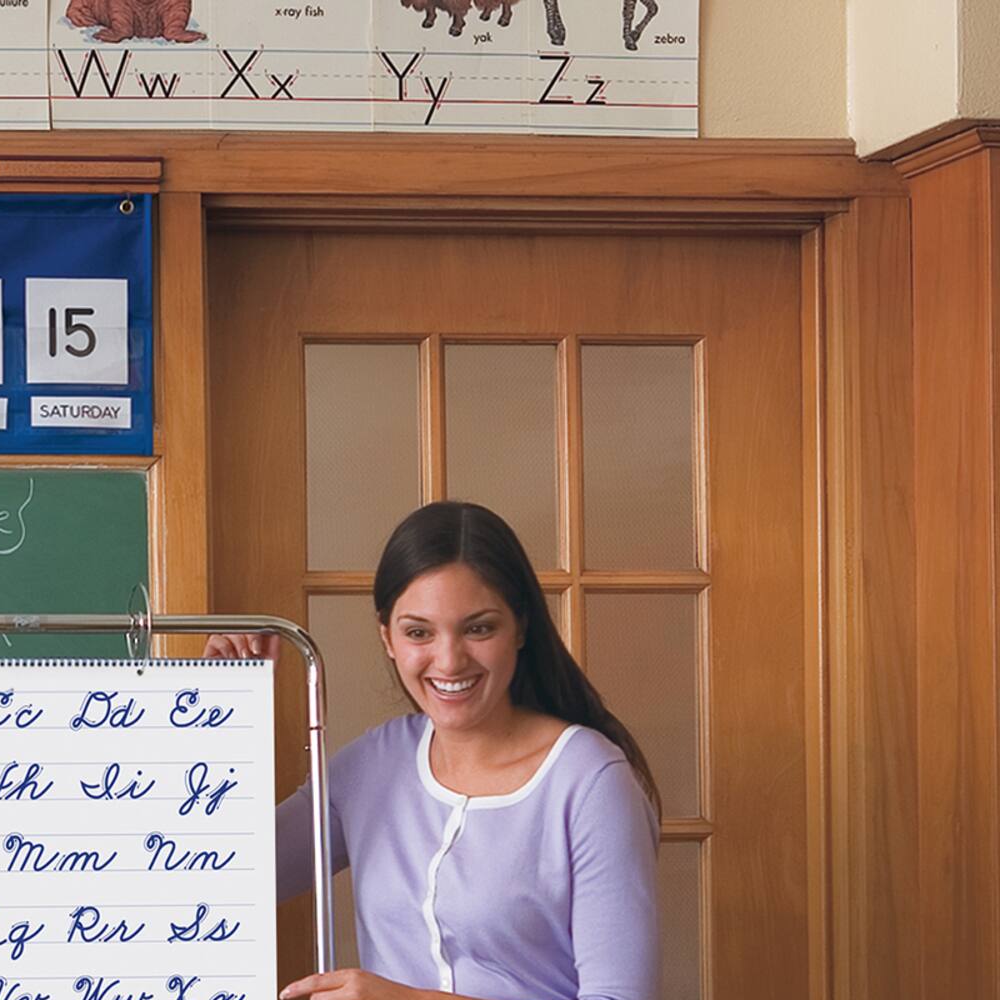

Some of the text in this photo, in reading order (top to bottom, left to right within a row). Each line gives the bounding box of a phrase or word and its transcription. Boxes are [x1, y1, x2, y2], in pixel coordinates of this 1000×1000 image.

[305, 4, 325, 17] fish
[473, 32, 493, 45] yak
[654, 34, 686, 45] zebra
[58, 49, 177, 99] Ww
[220, 49, 294, 100] Xx
[381, 51, 447, 126] Yy
[538, 55, 606, 106] Zz
[49, 307, 96, 357] 15
[39, 404, 121, 420] SATURDAY
[72, 691, 145, 728] Dd
[169, 691, 234, 728] Ee
[80, 762, 156, 800] Ii
[178, 762, 238, 816] Jj
[5, 835, 118, 872] Mm
[146, 834, 236, 871] Nn
[67, 906, 145, 943] Rr
[167, 905, 241, 943] Ss
